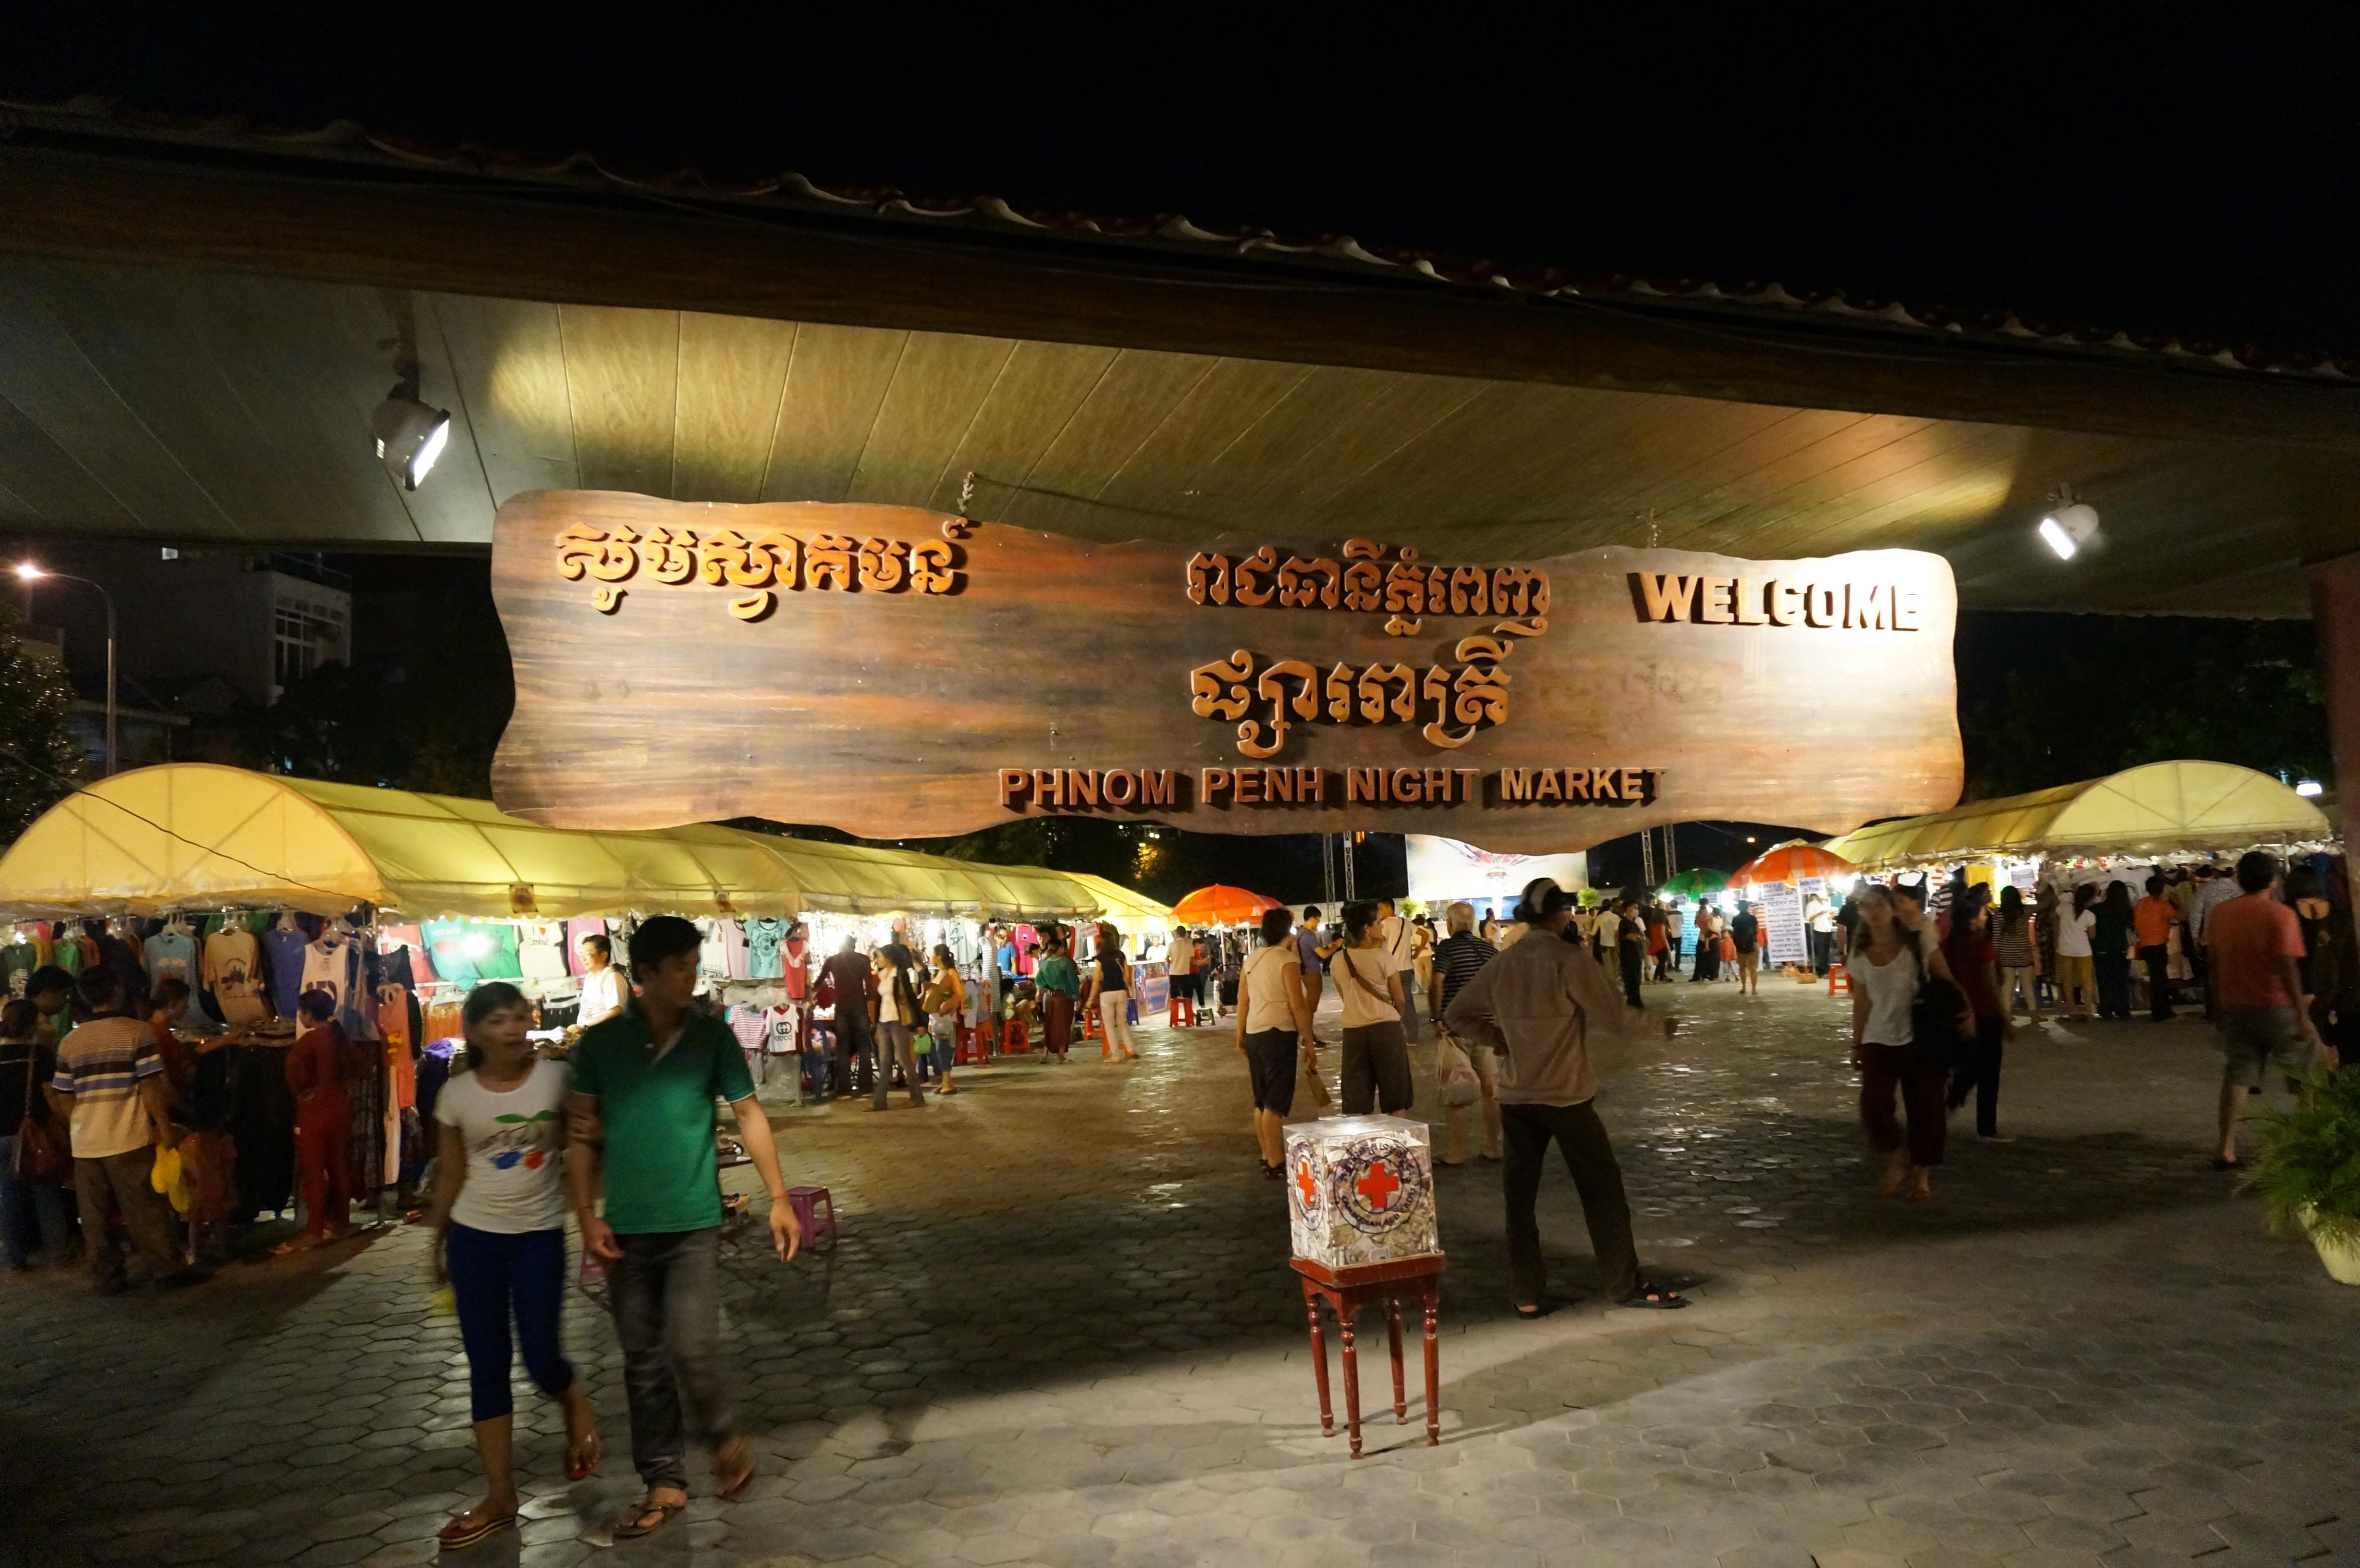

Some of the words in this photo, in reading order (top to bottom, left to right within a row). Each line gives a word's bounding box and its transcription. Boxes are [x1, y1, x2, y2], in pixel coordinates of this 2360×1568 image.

[1639, 572, 1922, 631] WELCOME
[999, 768, 1175, 805] PHNOM
[1202, 767, 1323, 803] PENH
[1347, 767, 1480, 802] NIGHT
[1500, 766, 1669, 800] MARKET
